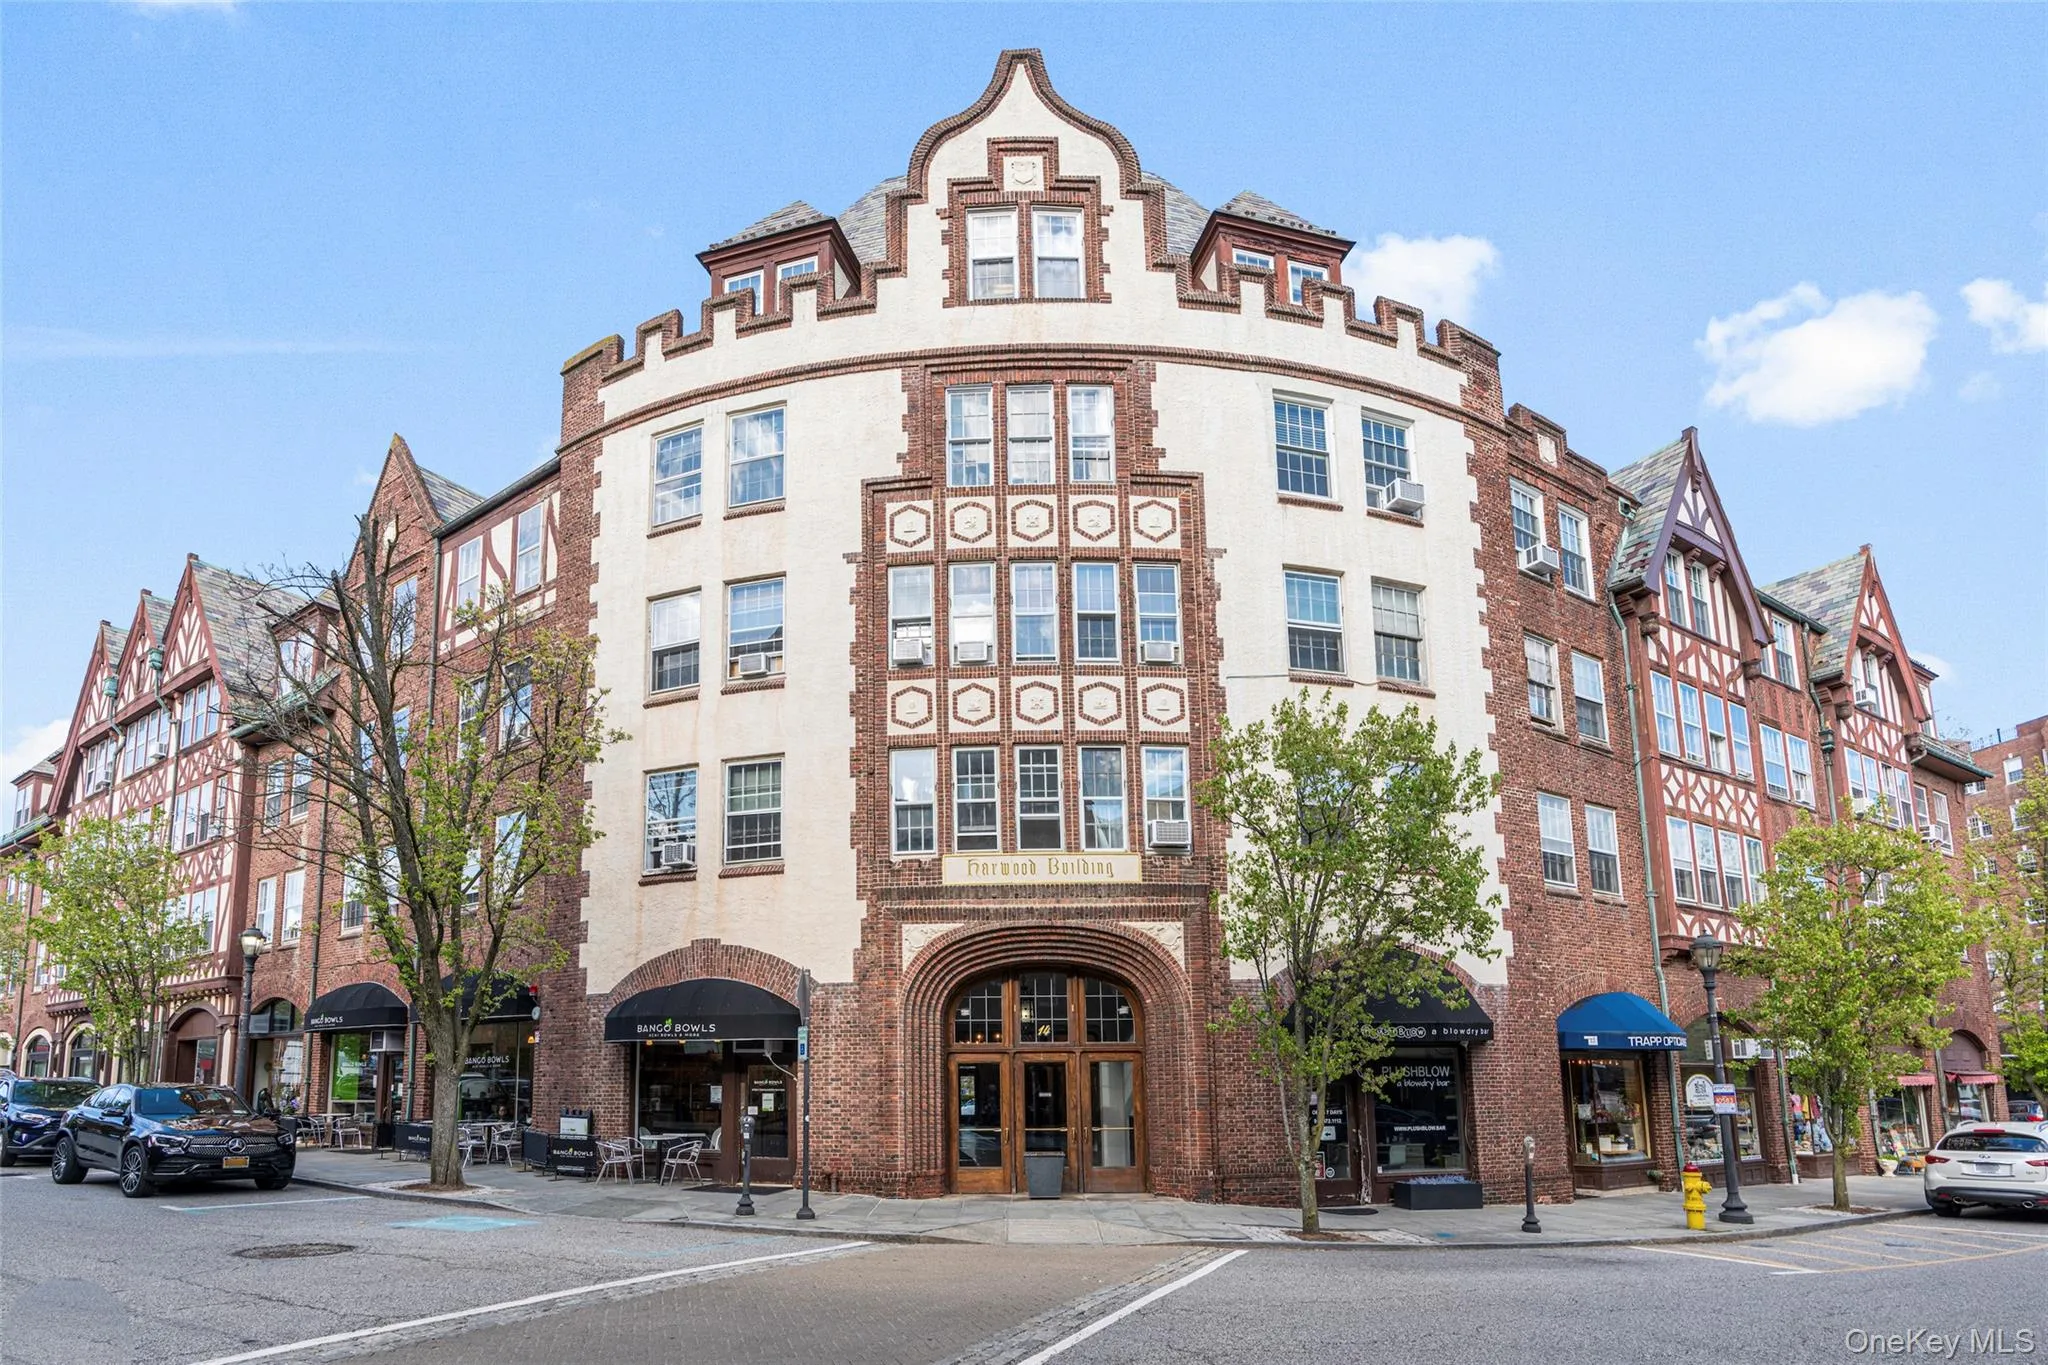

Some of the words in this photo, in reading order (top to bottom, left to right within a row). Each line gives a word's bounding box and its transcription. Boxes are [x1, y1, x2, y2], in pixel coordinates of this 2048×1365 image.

[967, 858, 1037, 877] Harwood
[1048, 857, 1114, 878] Building
[637, 1023, 671, 1033] BANGO
[674, 1023, 716, 1033] BOWLS
[1442, 1028, 1479, 1036] blowdry
[1627, 1036, 1662, 1047] TRAPP
[487, 1055, 510, 1064] BOWLS
[1403, 1078, 1435, 1090] blowdry
[1436, 1079, 1450, 1087] bar
